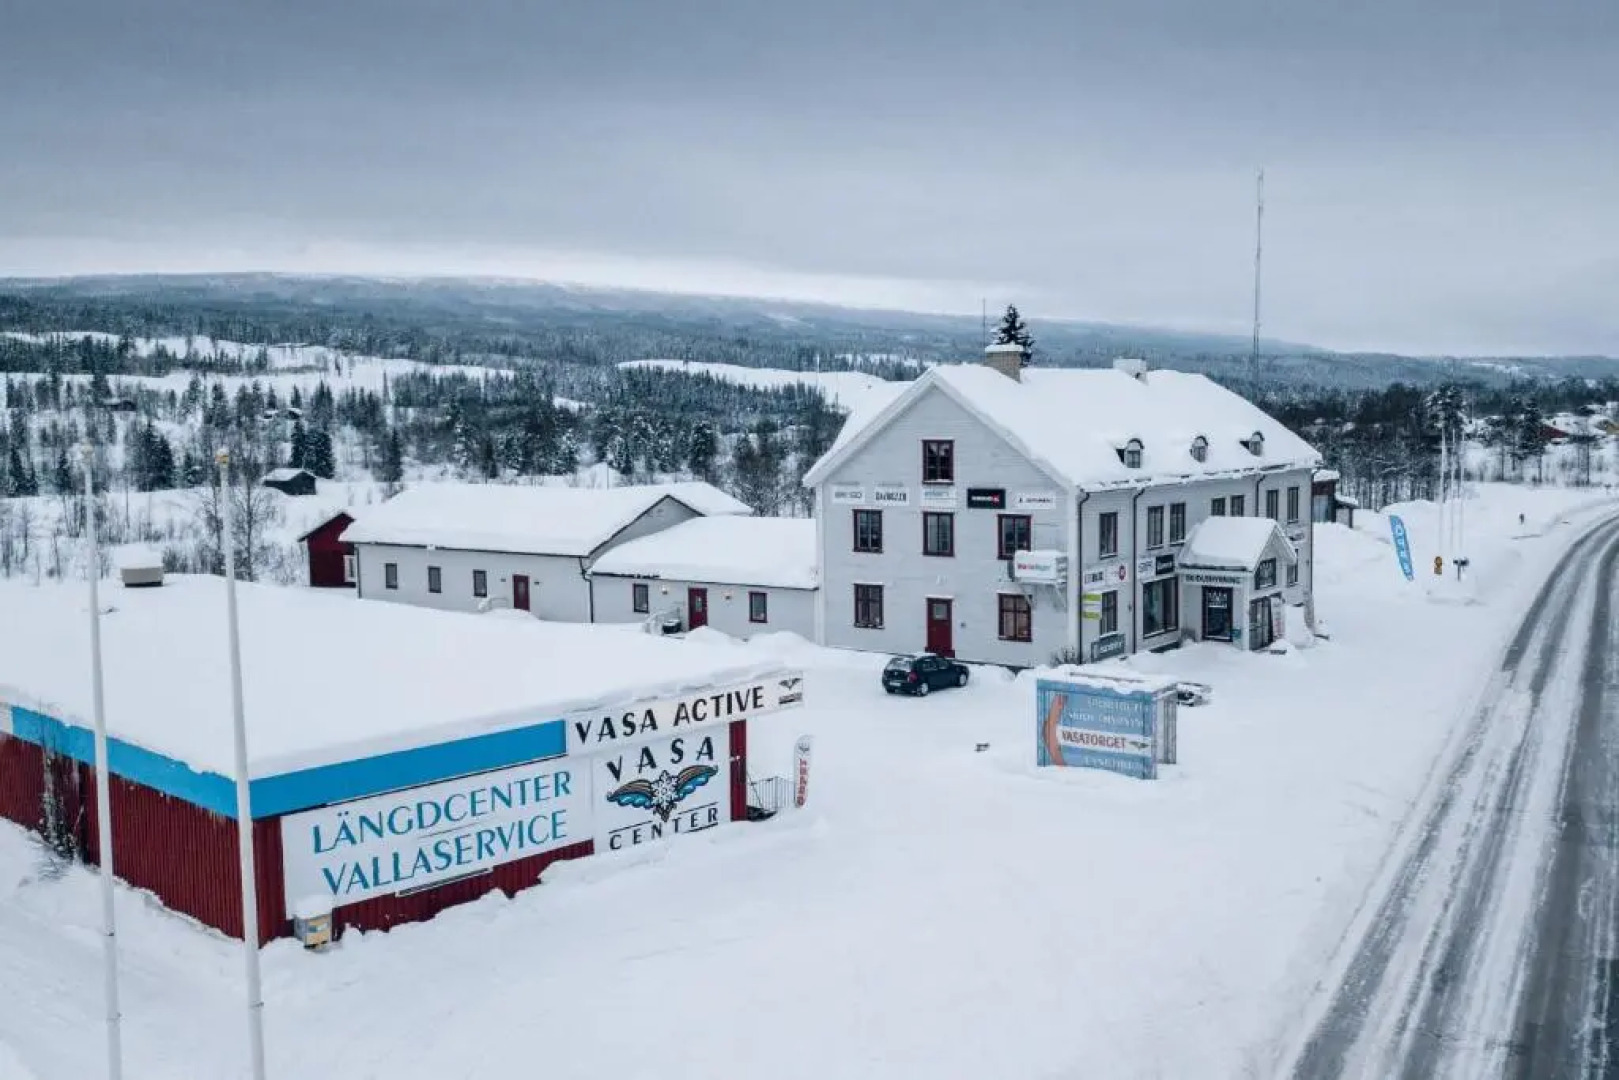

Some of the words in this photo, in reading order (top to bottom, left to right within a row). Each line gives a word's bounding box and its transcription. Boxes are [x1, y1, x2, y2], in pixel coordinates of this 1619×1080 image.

[575, 709, 658, 744] VASA
[673, 686, 764, 727] ACTIVE
[1062, 730, 1127, 749] VASATORGET
[606, 736, 714, 782] VASA
[313, 771, 572, 854] LÄNGDCENTER
[609, 807, 719, 850] CENTER
[322, 809, 567, 896] VALLASERVICE
